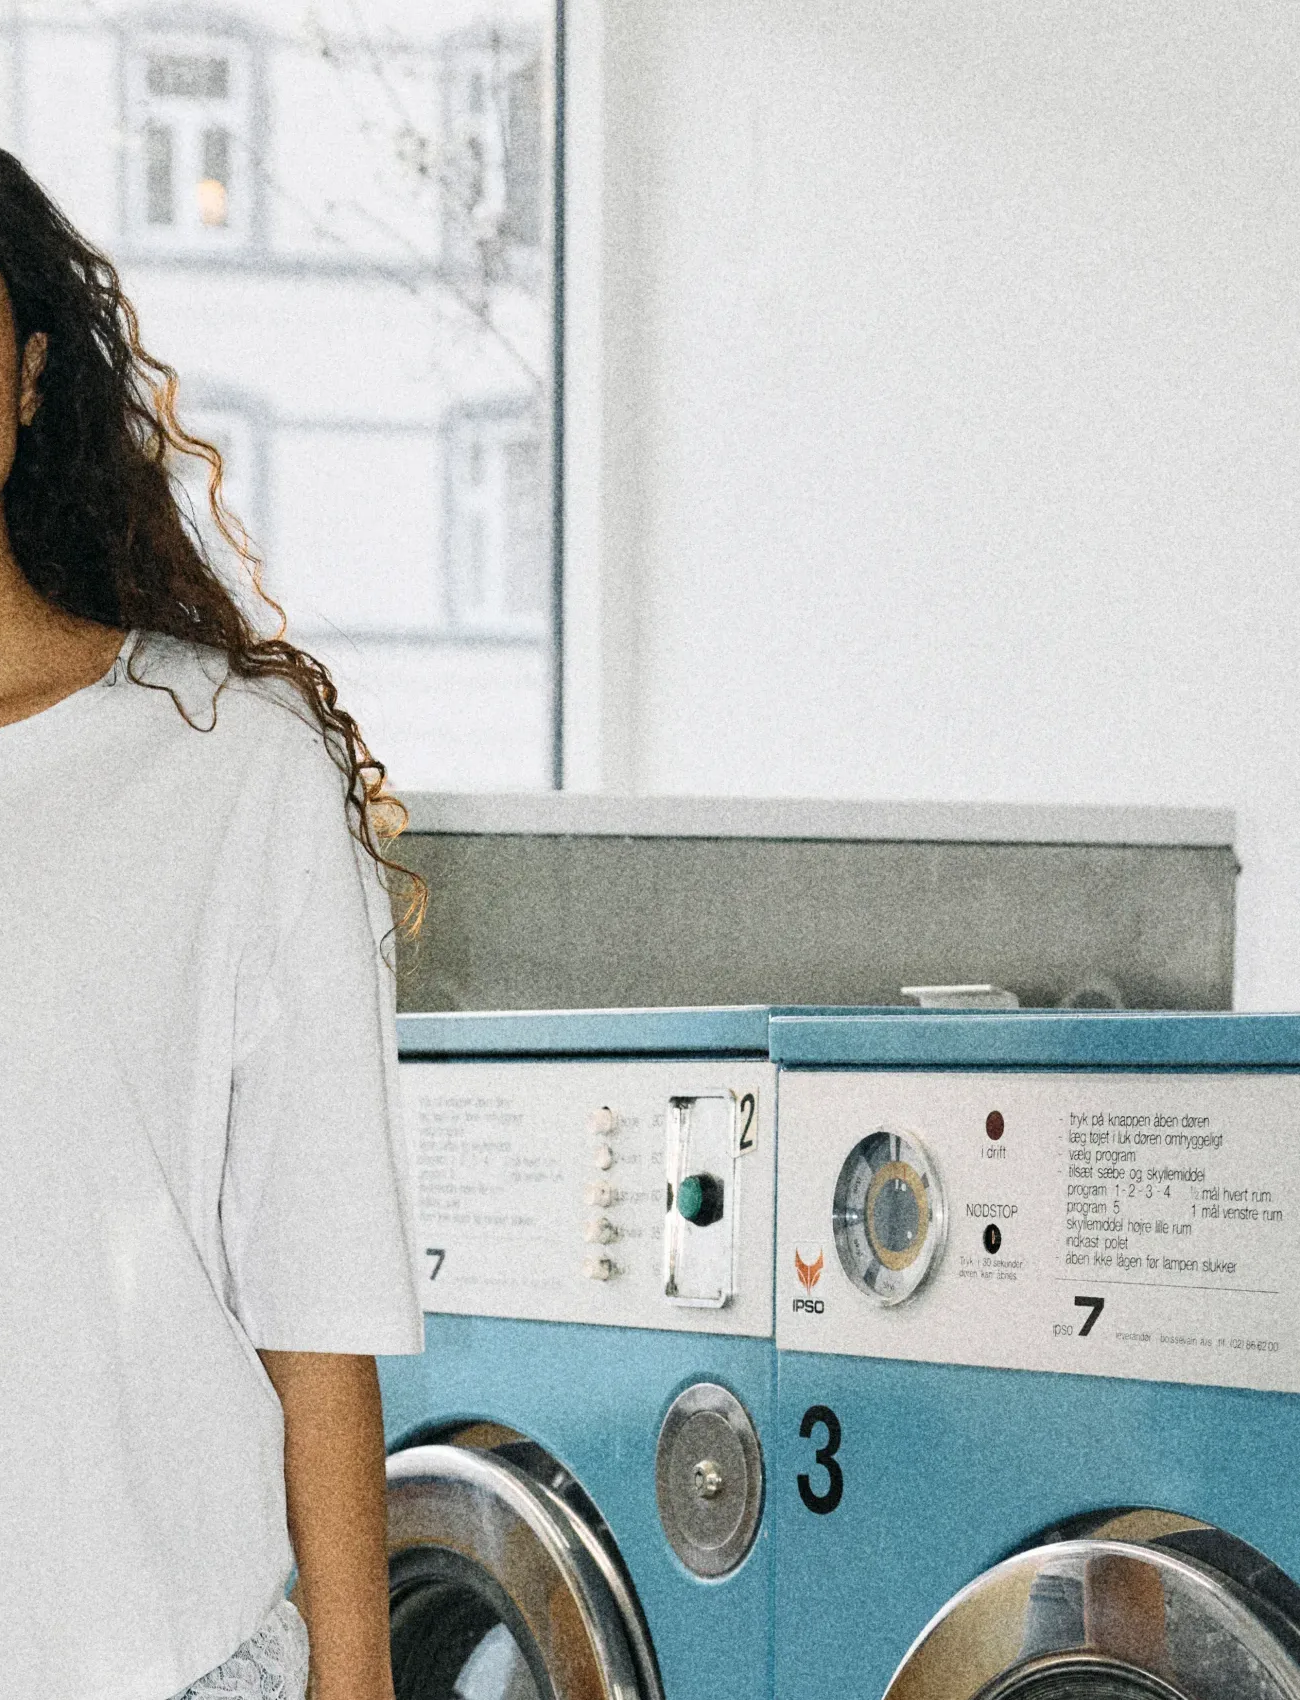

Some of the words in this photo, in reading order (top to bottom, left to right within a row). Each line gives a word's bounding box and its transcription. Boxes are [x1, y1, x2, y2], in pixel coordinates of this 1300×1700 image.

[739, 1093, 755, 1150] 2
[1070, 1112, 1088, 1129] tryk
[1092, 1113, 1104, 1129] på
[1108, 1113, 1150, 1129] knappen
[1153, 1113, 1179, 1128] åben
[1181, 1113, 1210, 1129] døren
[1069, 1131, 1086, 1147] læg
[1089, 1131, 1109, 1147] tøjet
[1117, 1131, 1131, 1145] luk
[1134, 1132, 1162, 1146] døren
[1164, 1132, 1223, 1149] omhyggeligt
[986, 1145, 1007, 1159] drift
[1069, 1149, 1091, 1164] vælg
[1095, 1151, 1136, 1164] program
[1068, 1166, 1093, 1179] tilsæt
[1097, 1166, 1125, 1180] sæbe
[1129, 1168, 1142, 1183] og
[1146, 1166, 1206, 1183] skyllemiddel
[1067, 1184, 1107, 1200] program
[1202, 1186, 1220, 1201] mål
[1223, 1187, 1248, 1202] hvert
[1066, 1201, 1107, 1217] program
[1113, 1201, 1120, 1214] 5
[1191, 1204, 1196, 1218] 1
[1202, 1204, 1220, 1219] mål
[1223, 1206, 1259, 1220] venstre
[1262, 1209, 1283, 1221] rum
[1066, 1218, 1123, 1234] skyllemiddel
[1127, 1219, 1152, 1235] højre
[1172, 1222, 1192, 1235] rum
[1104, 1235, 1128, 1251] polet
[426, 1247, 446, 1281] 7
[1065, 1251, 1090, 1265] åben
[1093, 1252, 1113, 1267] ikke
[1116, 1253, 1142, 1270] lågen
[1146, 1254, 1159, 1269] før
[1162, 1256, 1198, 1272] lampen
[1202, 1257, 1237, 1274] slukker
[792, 1299, 825, 1314] IPSO
[1052, 1323, 1073, 1338] ipso
[1074, 1295, 1105, 1337] 7
[796, 1404, 844, 1515] 3
